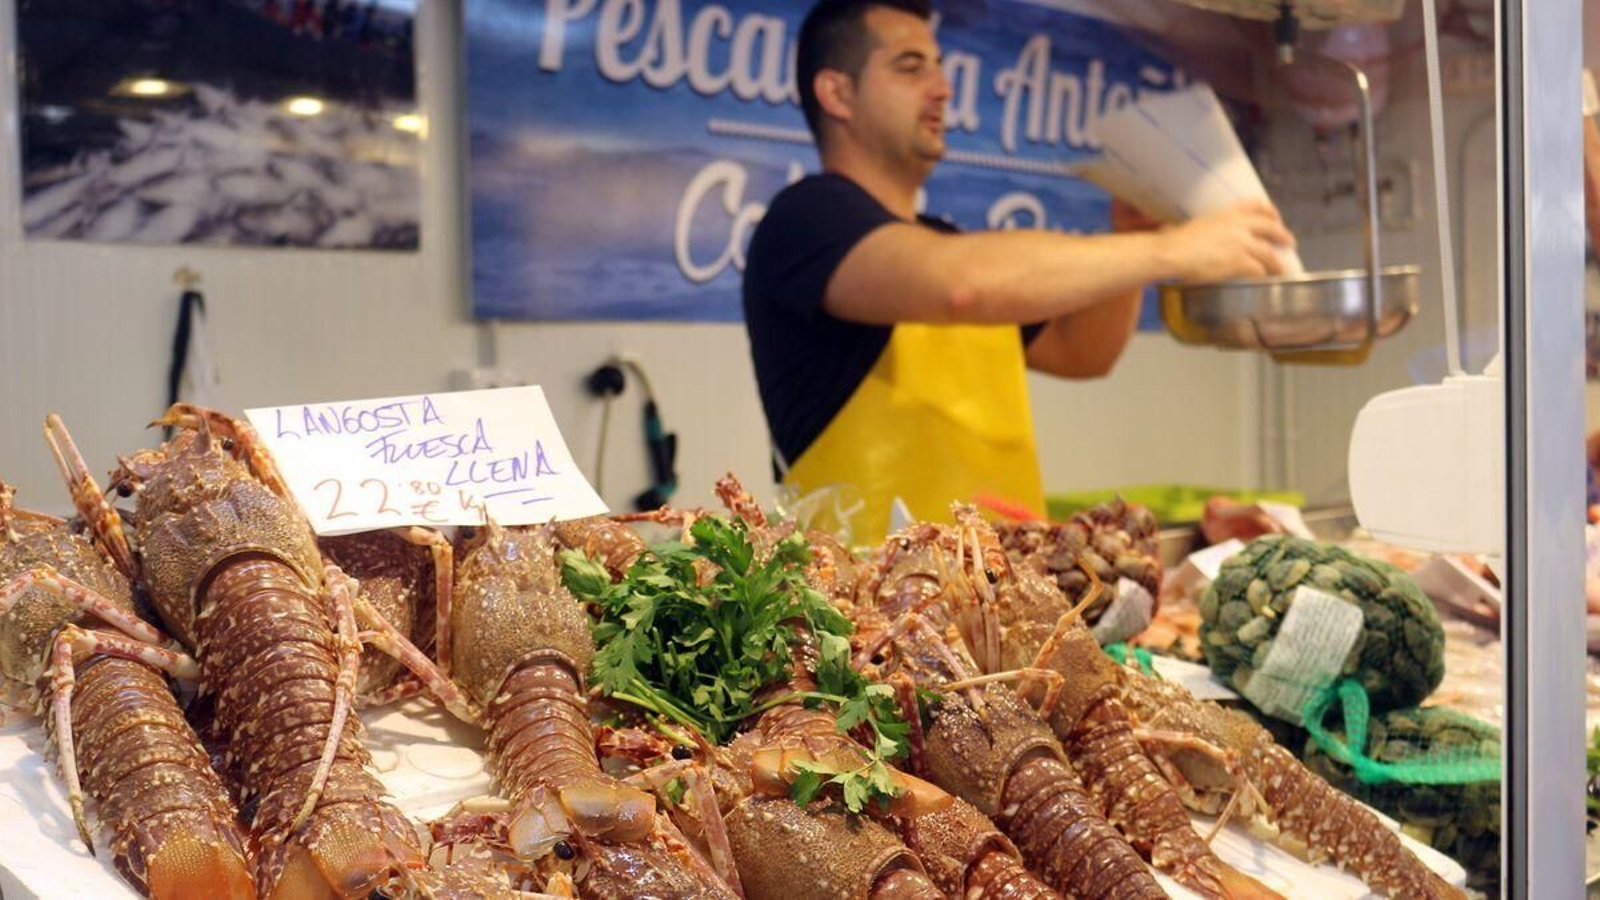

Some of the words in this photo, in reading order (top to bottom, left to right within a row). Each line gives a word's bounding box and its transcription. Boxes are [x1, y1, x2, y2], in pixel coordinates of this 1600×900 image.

[538, 0, 981, 134] Pescaa
[276, 396, 444, 440] LANGOSTA
[445, 439, 561, 486] LLENA
